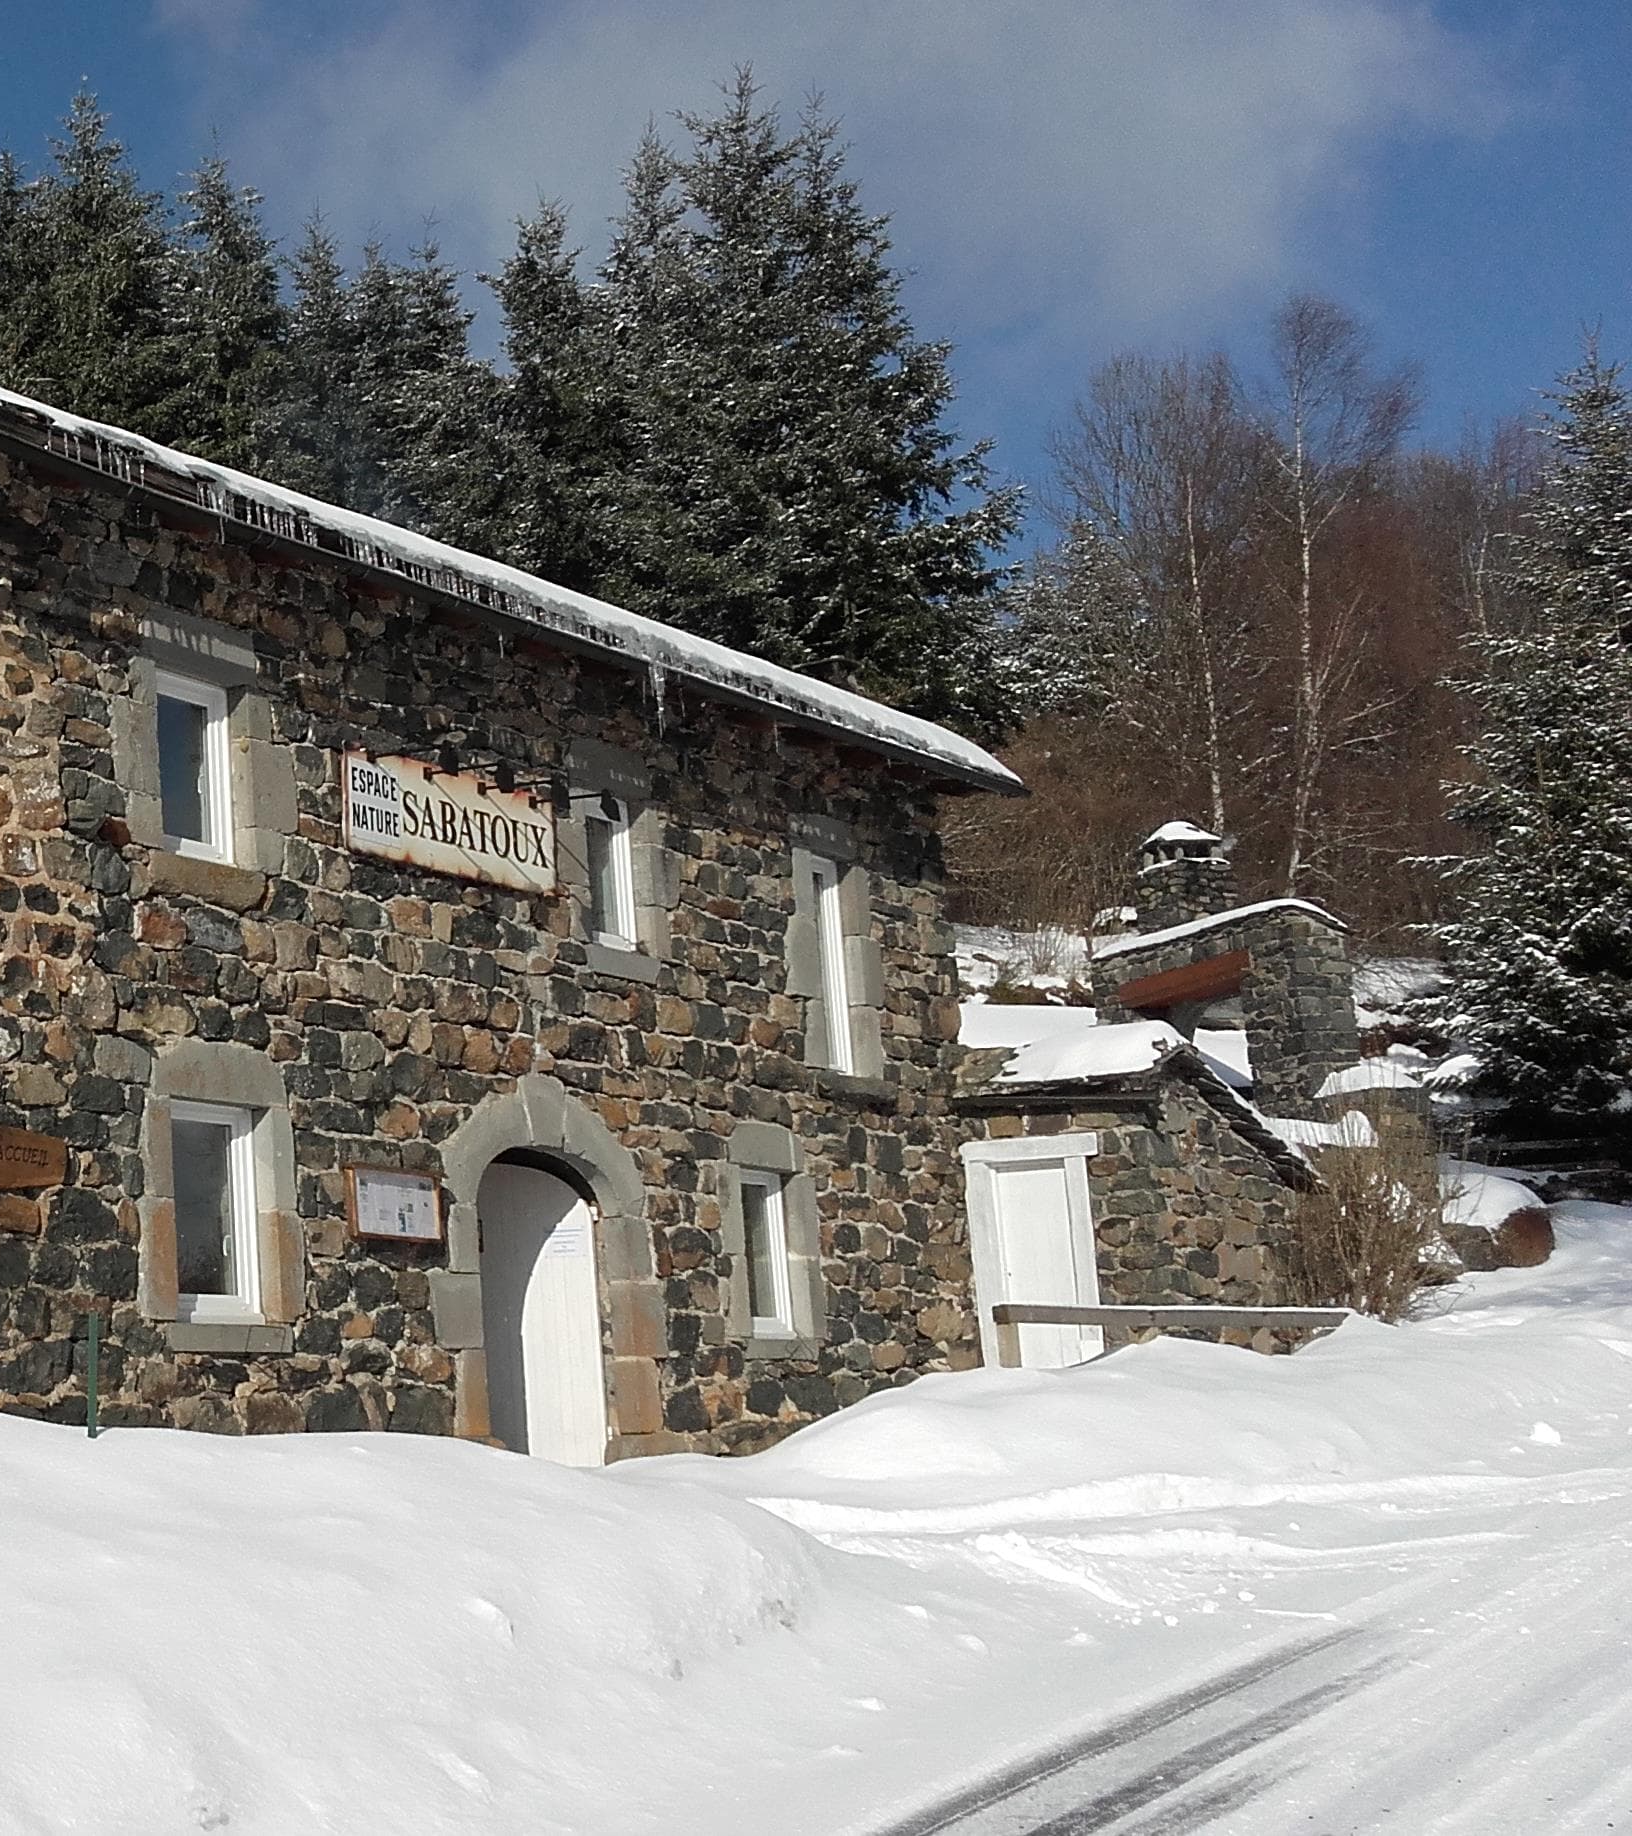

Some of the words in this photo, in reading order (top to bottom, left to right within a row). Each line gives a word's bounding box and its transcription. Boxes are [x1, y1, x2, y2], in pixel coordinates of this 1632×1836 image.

[351, 766, 398, 802] ESPACE
[352, 802, 400, 838] NATURE
[402, 790, 550, 869] SABATOUX
